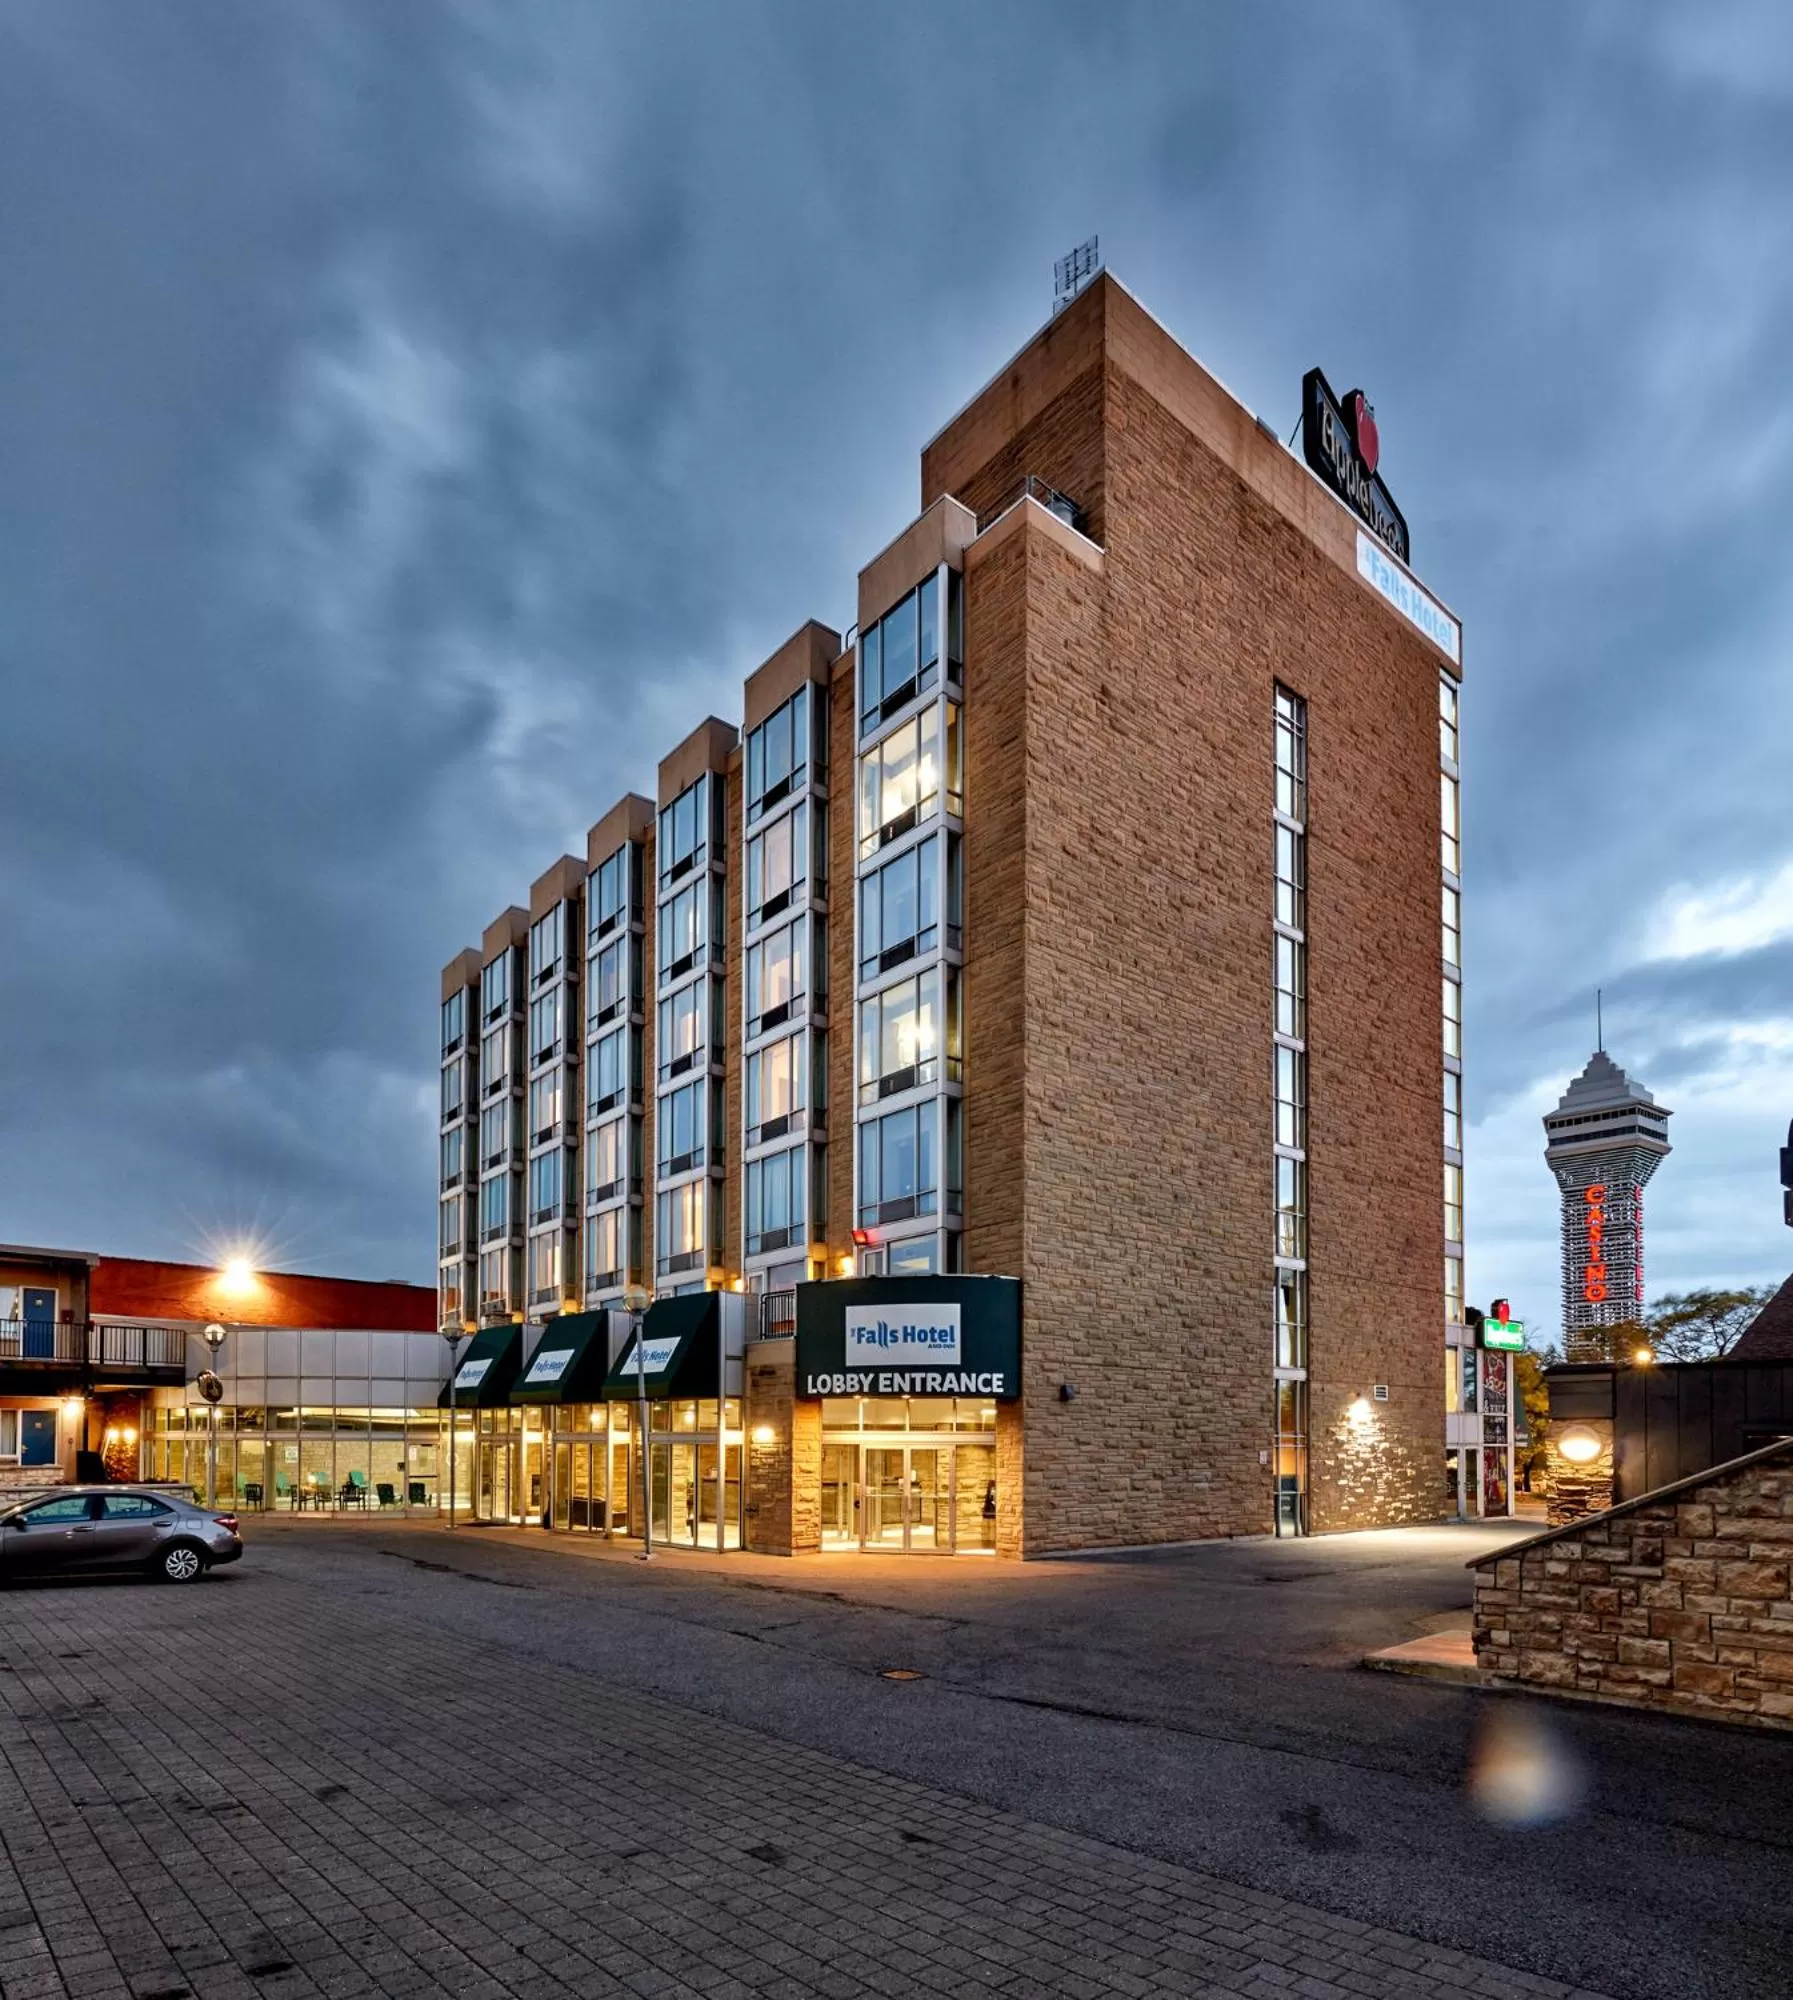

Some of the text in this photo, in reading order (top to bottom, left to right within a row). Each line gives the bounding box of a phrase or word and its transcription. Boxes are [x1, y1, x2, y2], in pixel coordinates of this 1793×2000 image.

[1371, 549, 1454, 652] Falls Hotel
[1585, 1184, 1606, 1301] CASINO
[857, 1320, 899, 1348] Falls
[902, 1325, 955, 1343] Hotel
[807, 1372, 1004, 1394] LOBBY ENTRANCE
